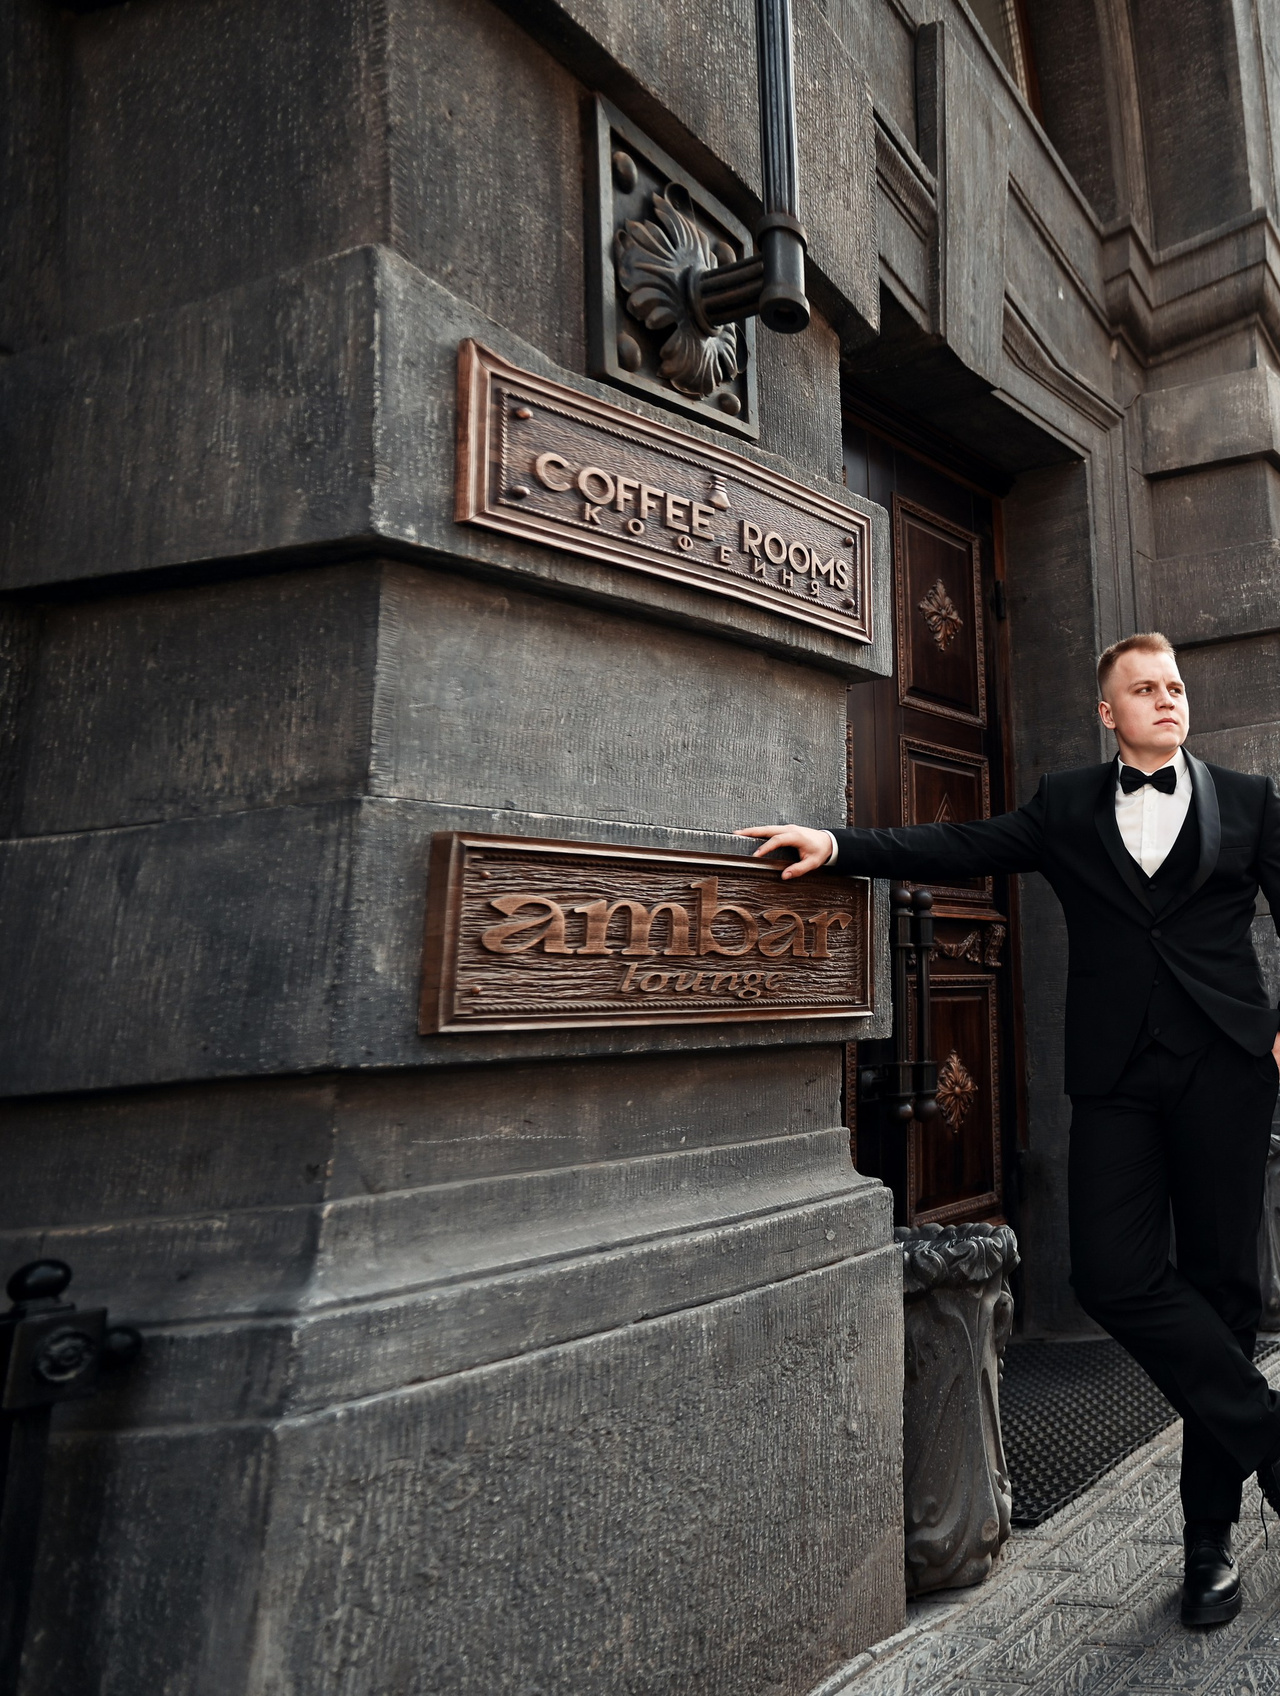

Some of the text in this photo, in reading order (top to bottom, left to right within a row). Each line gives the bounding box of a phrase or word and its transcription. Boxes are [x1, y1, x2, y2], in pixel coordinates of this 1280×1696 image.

[534, 451, 850, 592] COFFEE ROOMS
[480, 875, 854, 959] ambar
[618, 961, 786, 1000] lounge
